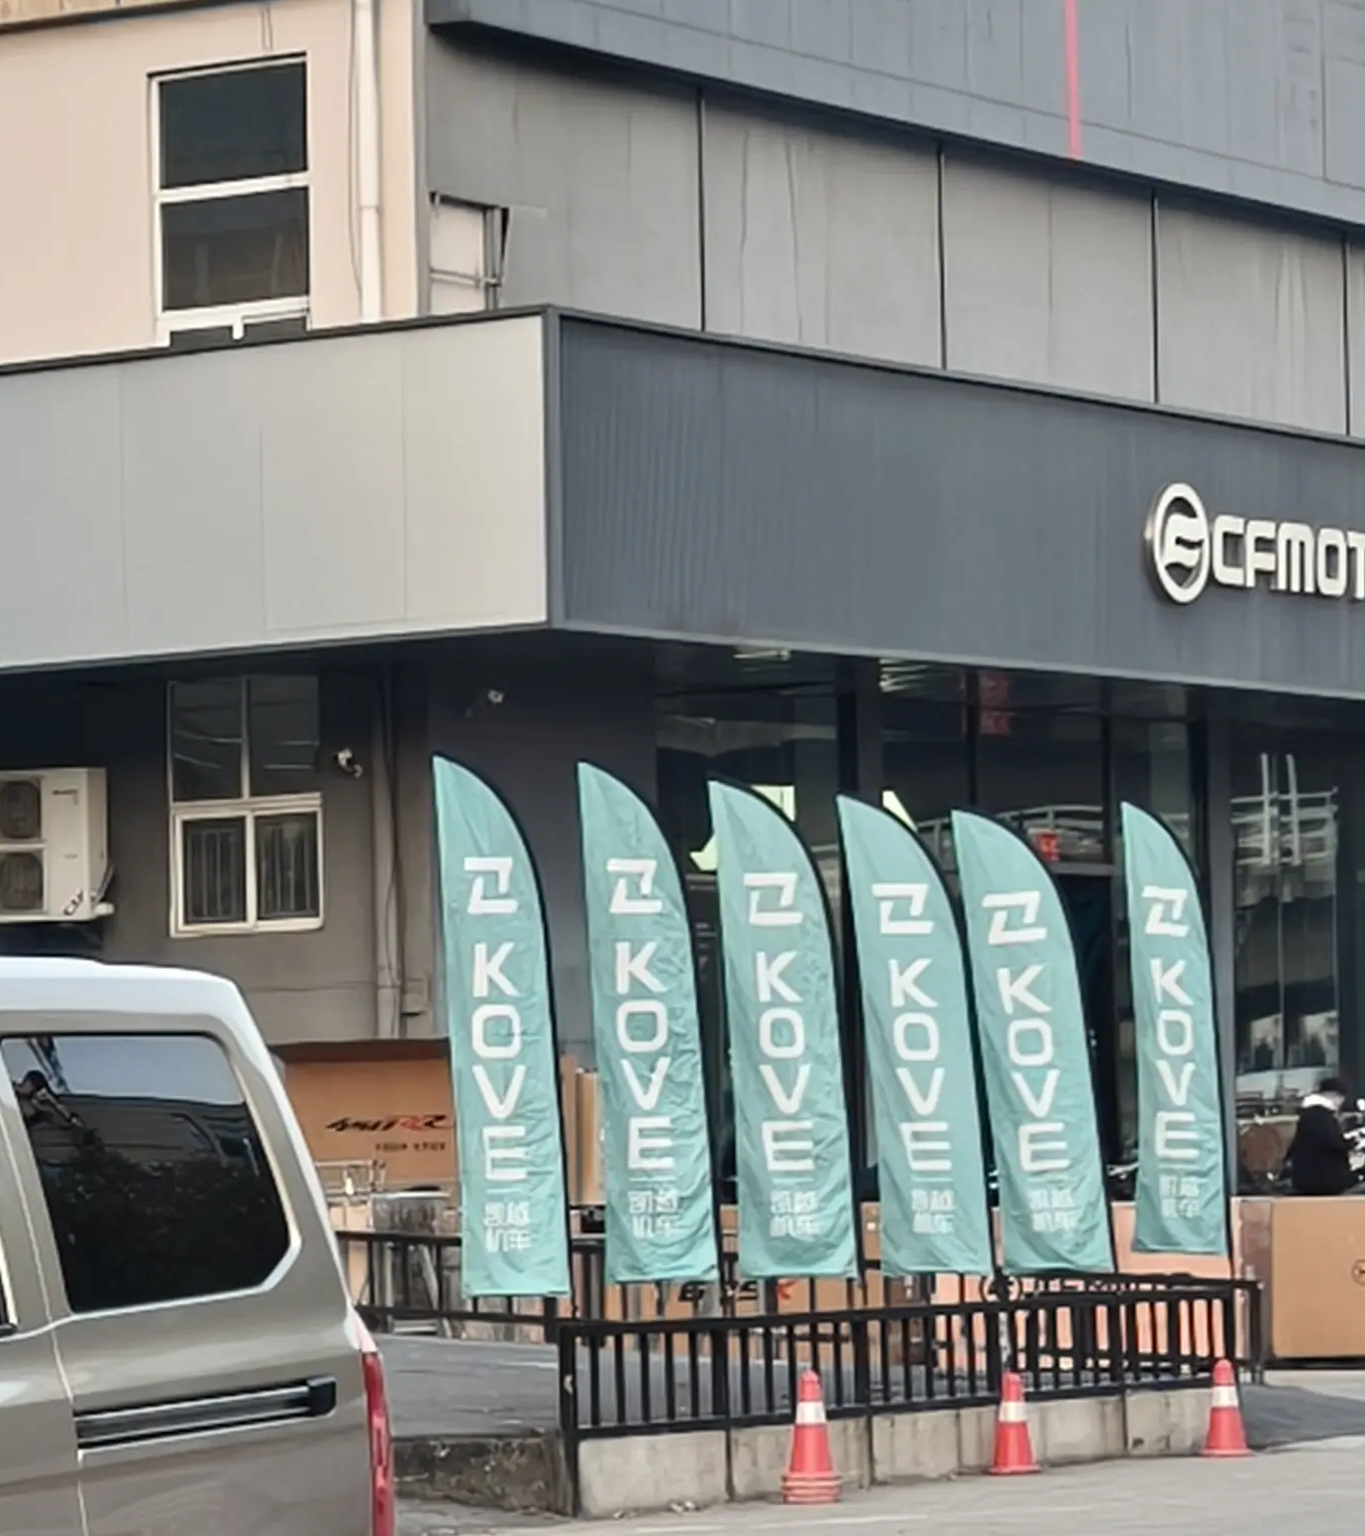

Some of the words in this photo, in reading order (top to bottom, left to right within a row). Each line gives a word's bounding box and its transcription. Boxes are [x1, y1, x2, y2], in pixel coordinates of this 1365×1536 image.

[471, 941, 526, 1181] KOVE
[614, 941, 676, 1170] KOVE
[755, 952, 814, 1171] KOVE
[887, 958, 953, 1172] KOVE
[996, 964, 1070, 1172] KOVE
[1148, 958, 1200, 1159] KOVE
